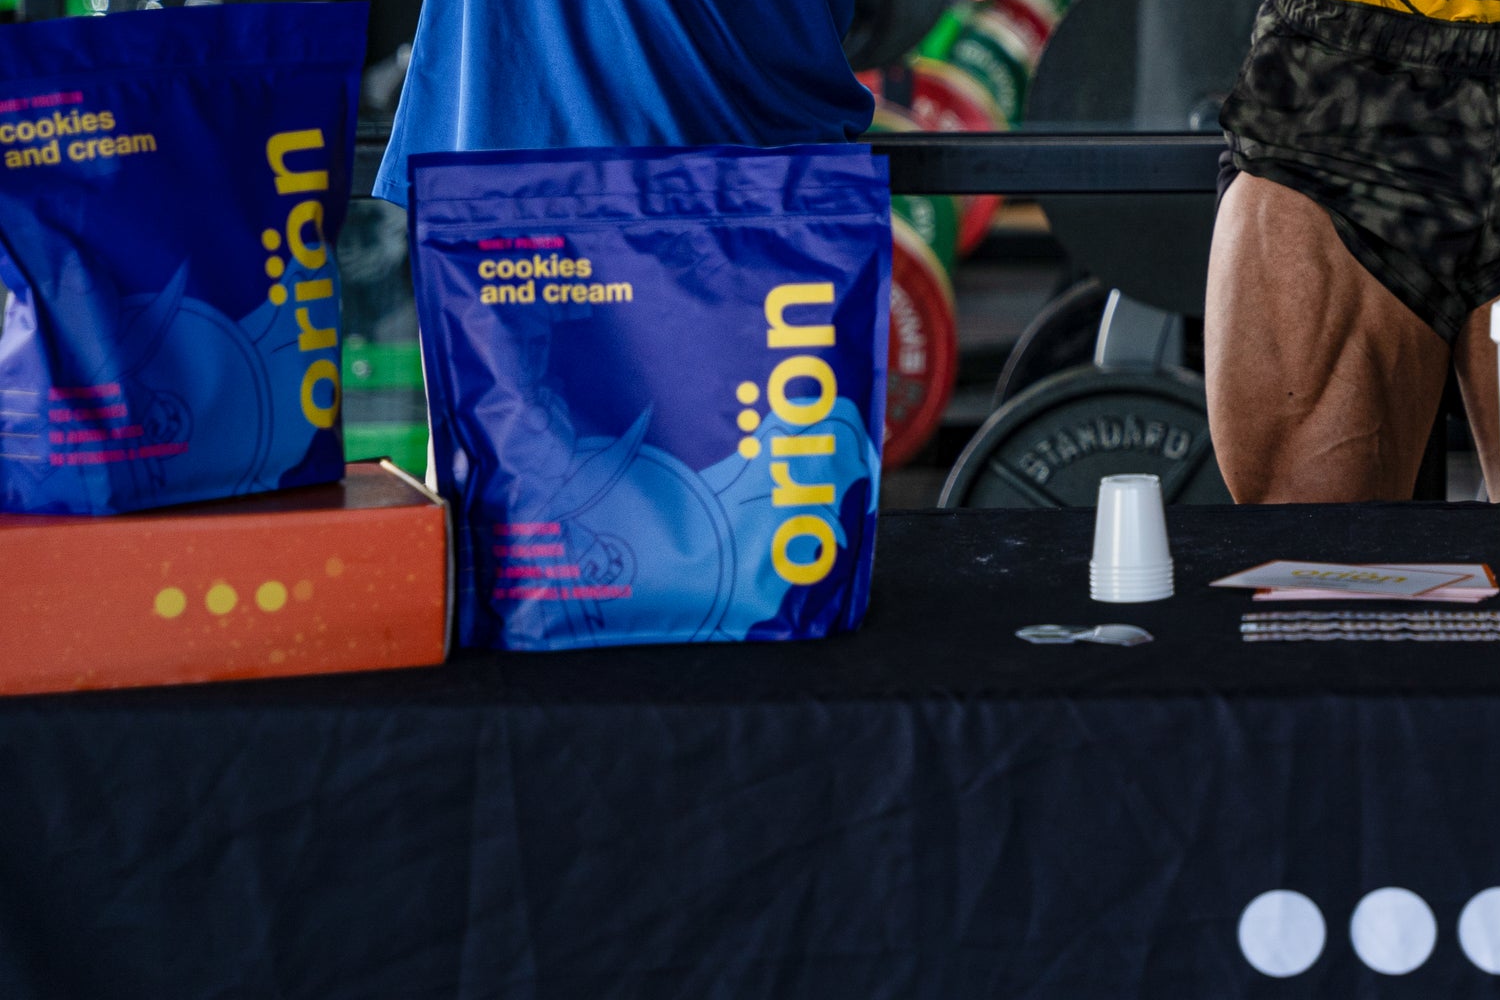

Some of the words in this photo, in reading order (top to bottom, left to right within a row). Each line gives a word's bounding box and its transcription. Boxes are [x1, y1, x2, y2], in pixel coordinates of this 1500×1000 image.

[0, 109, 116, 144] cookies
[4, 139, 62, 168] and
[67, 133, 158, 162] cream
[478, 253, 592, 280] cookies
[480, 279, 536, 304] and
[542, 281, 633, 304] cream
